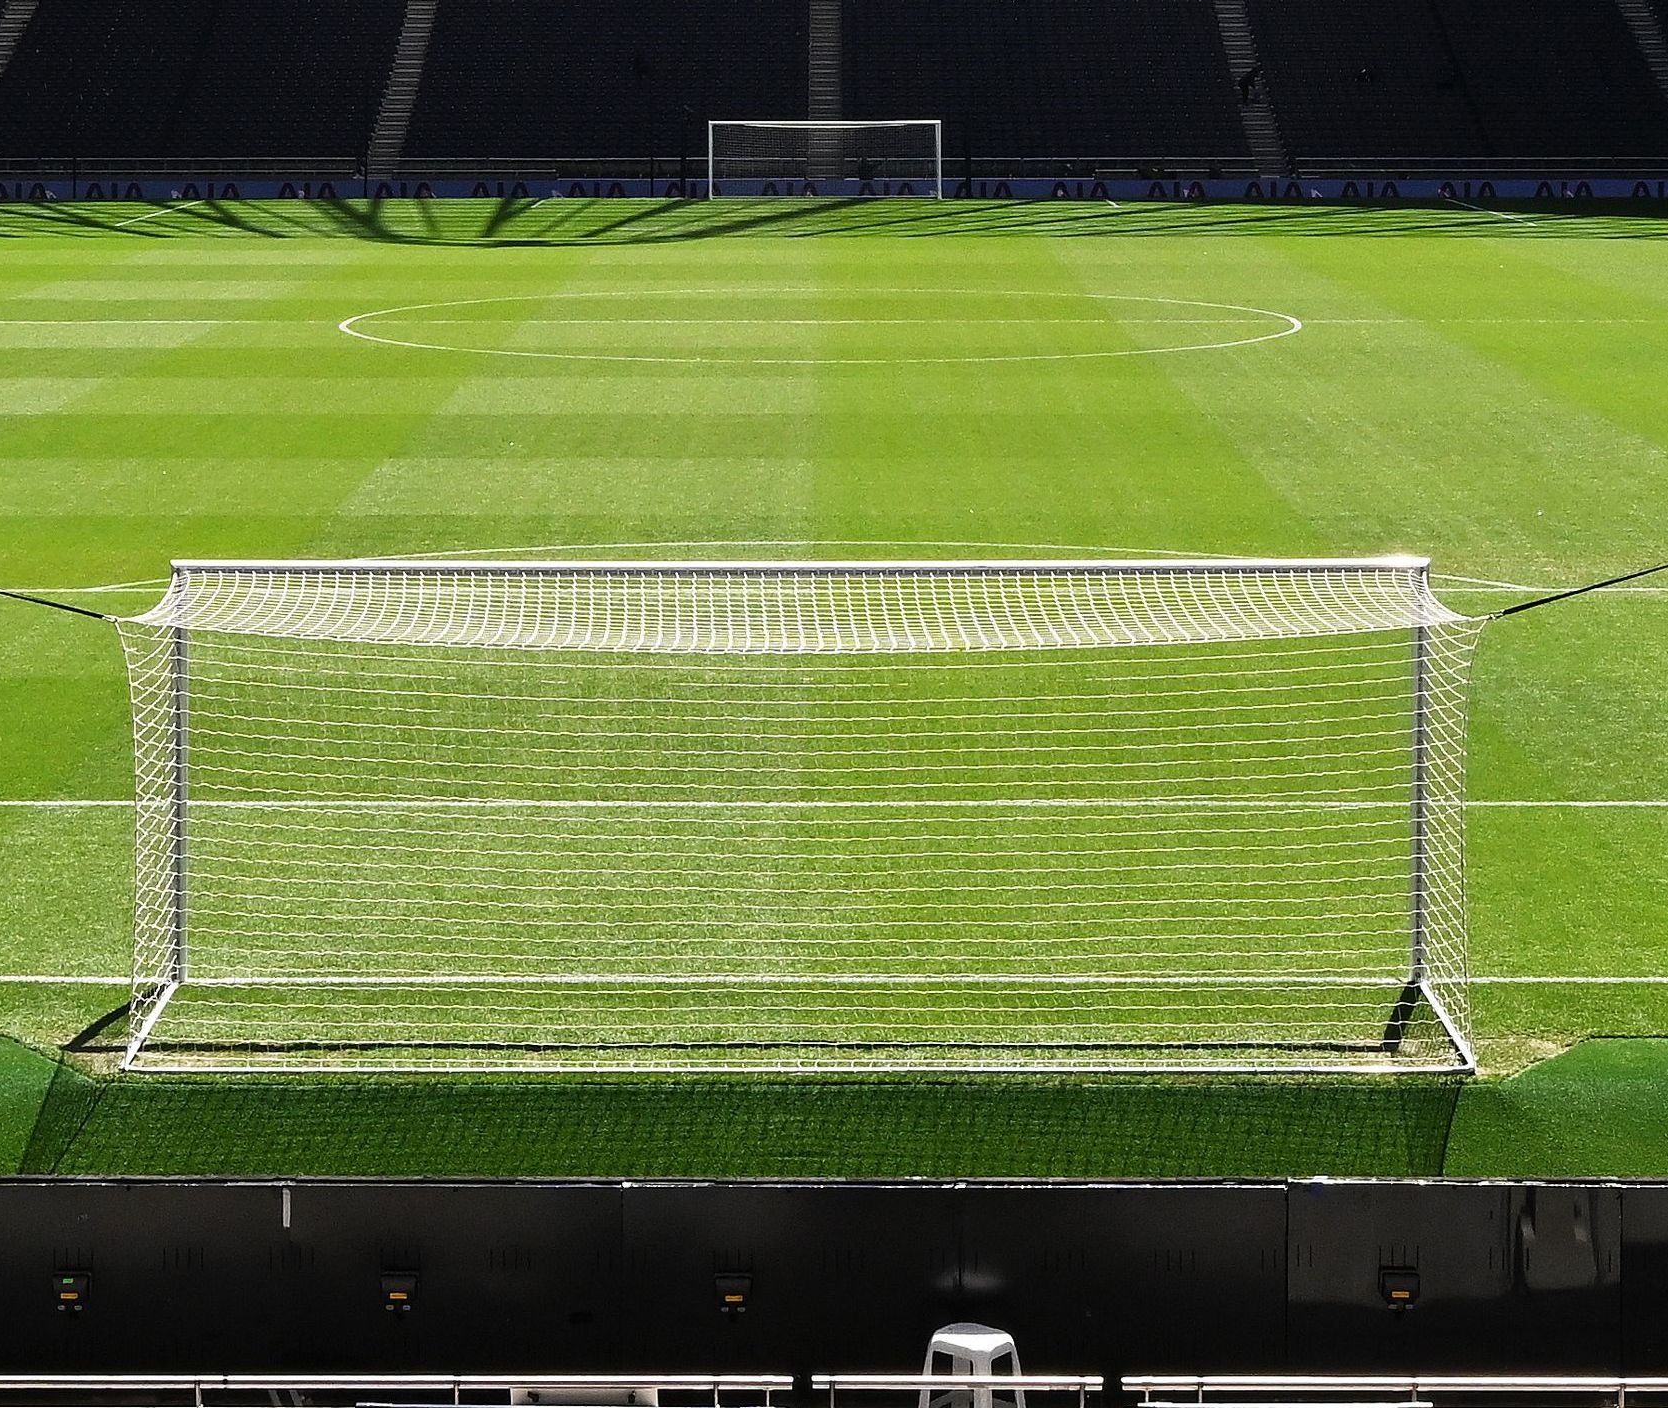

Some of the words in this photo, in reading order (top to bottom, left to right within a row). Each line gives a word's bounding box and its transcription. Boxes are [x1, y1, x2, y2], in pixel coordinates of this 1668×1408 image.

[85, 182, 144, 199] AIA
[181, 182, 242, 199] AIA
[472, 182, 529, 198] AIA
[569, 182, 626, 198] AIA
[1244, 182, 1303, 198] AIA
[1341, 182, 1399, 198] AIA
